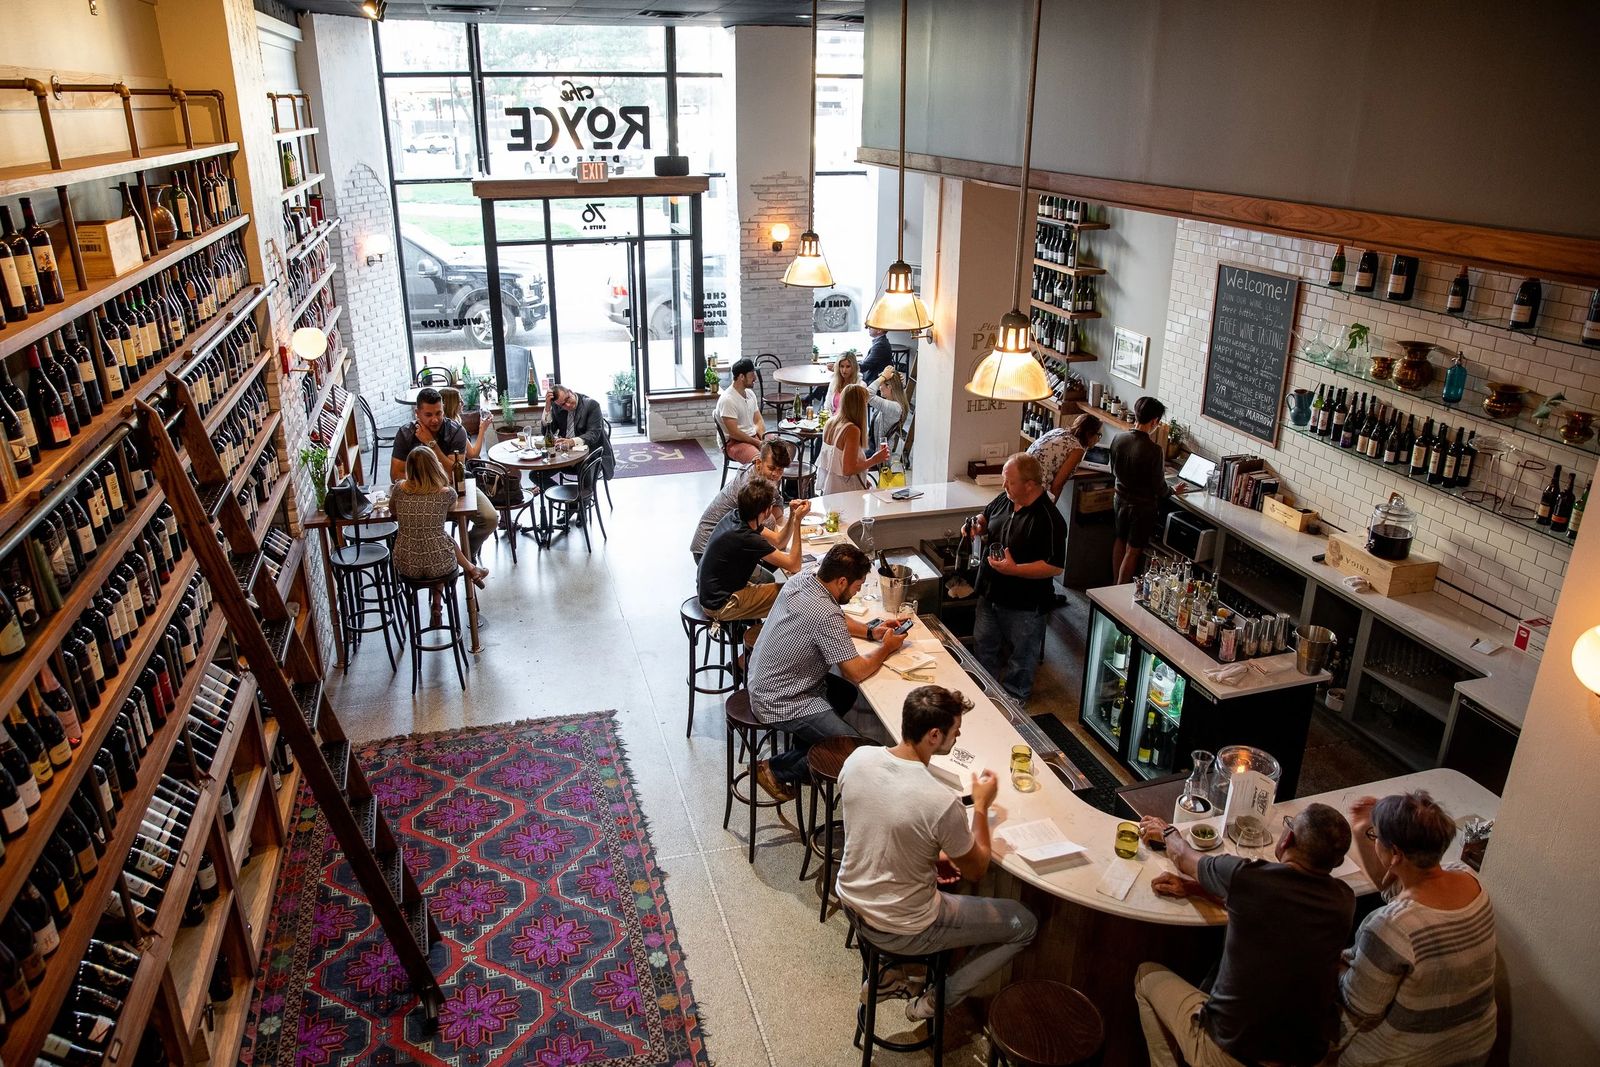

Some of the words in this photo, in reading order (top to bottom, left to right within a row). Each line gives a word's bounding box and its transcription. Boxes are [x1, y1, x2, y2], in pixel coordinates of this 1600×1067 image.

[582, 163, 604, 180] EXIT
[1224, 268, 1290, 301] Welcome!
[1219, 316, 1237, 335] FREE
[1239, 322, 1256, 341] WINE
[1257, 327, 1285, 350] TASTING
[1215, 344, 1232, 355] HAPPY
[1235, 350, 1251, 362] HOUR
[967, 399, 1007, 412] HERE
[1255, 391, 1274, 405] EVENTS
